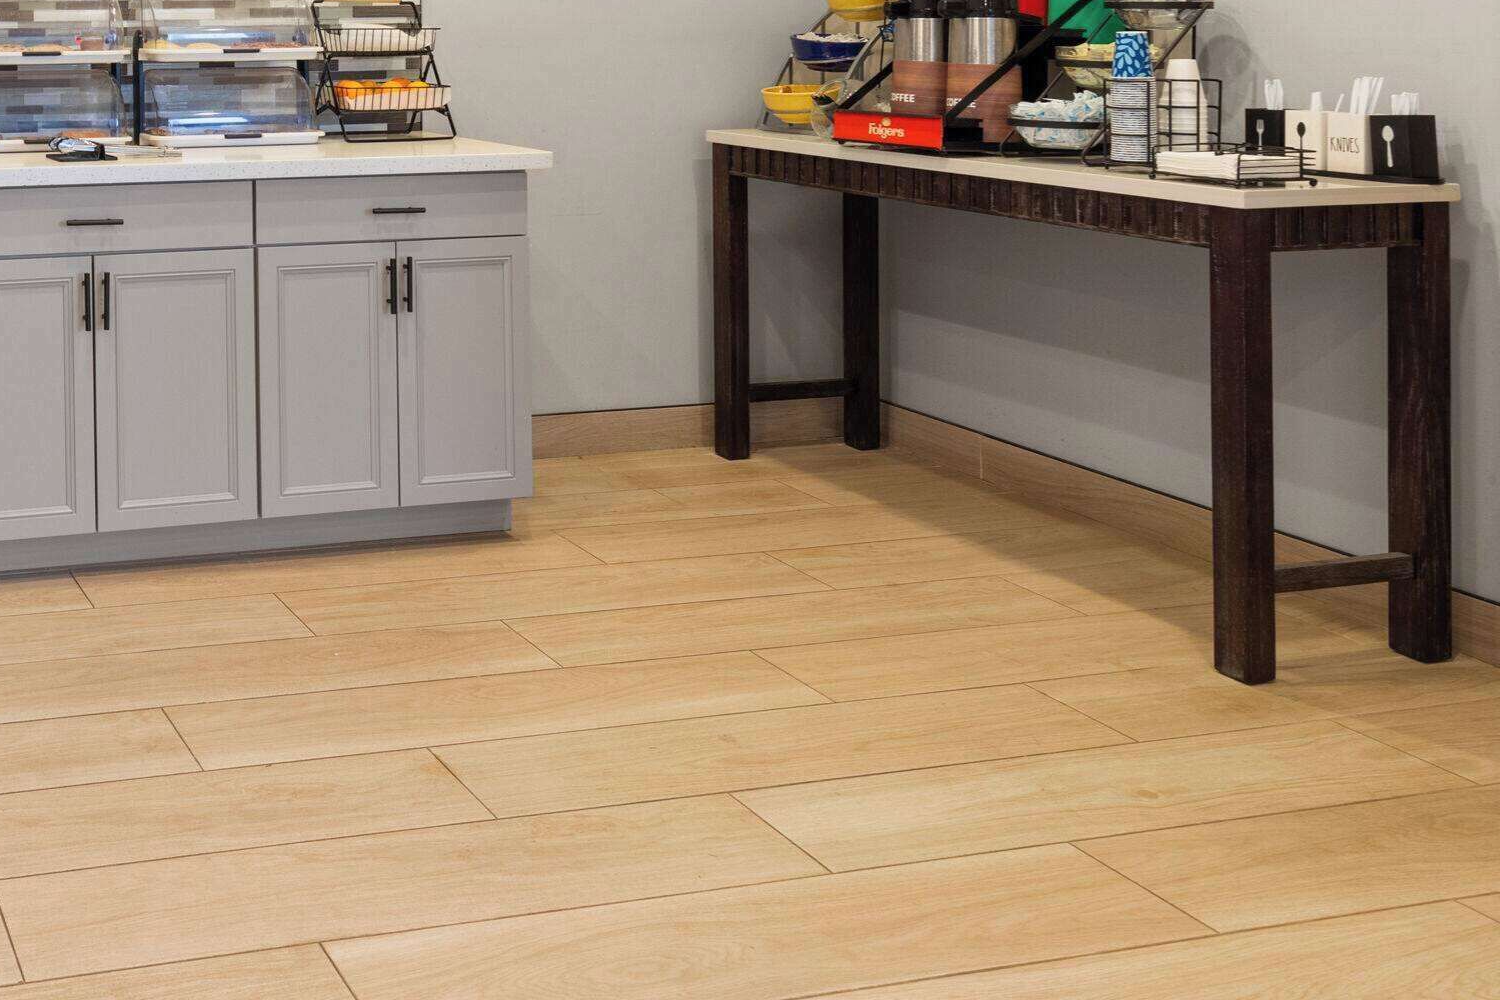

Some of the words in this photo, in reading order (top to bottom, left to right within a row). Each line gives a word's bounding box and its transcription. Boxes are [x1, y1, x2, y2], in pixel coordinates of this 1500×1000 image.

[891, 93, 916, 103] OFFEE
[868, 122, 905, 139] Folgers
[1329, 137, 1360, 153] KNIVES
